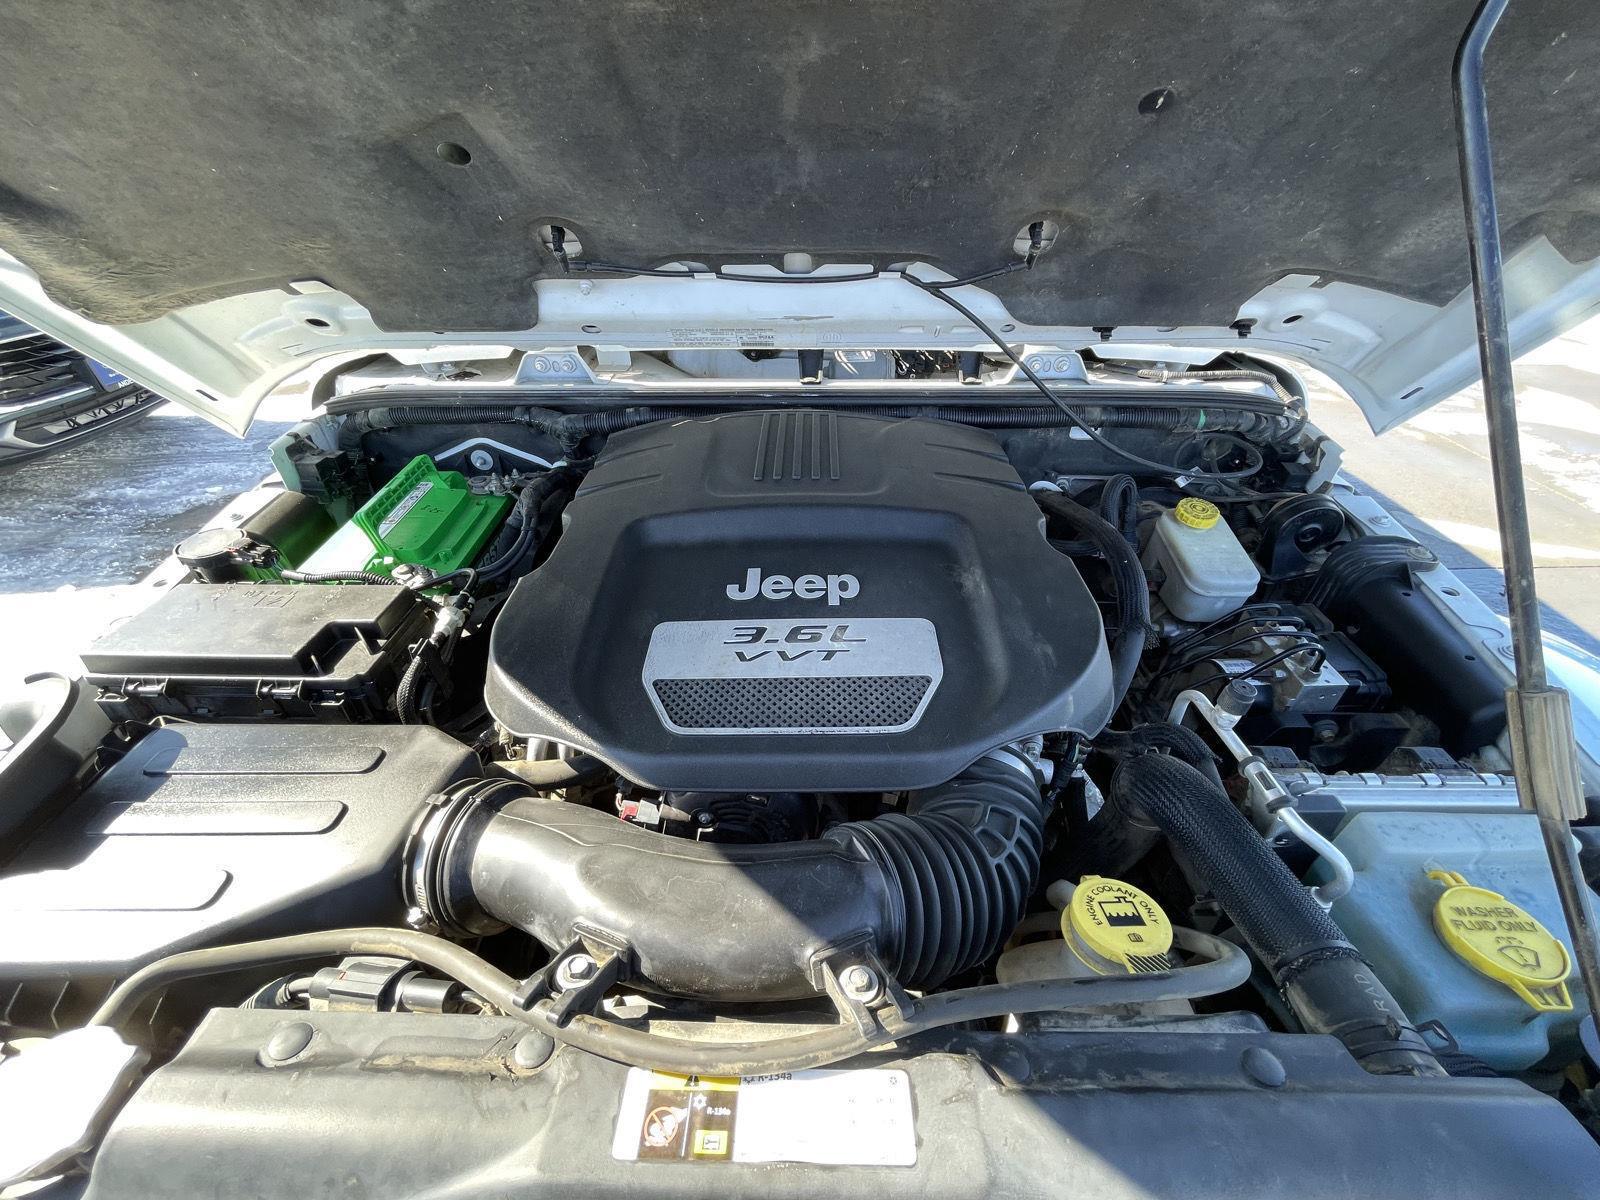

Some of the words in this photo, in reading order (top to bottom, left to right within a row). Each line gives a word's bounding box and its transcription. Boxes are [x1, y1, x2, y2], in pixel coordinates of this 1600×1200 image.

[726, 568, 860, 606] Jeep
[724, 625, 867, 645] 3.6L
[735, 650, 851, 663] VVT
[1091, 885, 1138, 899] COOLANT
[1085, 895, 1104, 926] ENGINE
[1139, 900, 1160, 925] ONLY
[1450, 906, 1519, 918] WASHER
[1451, 919, 1498, 931] FLUID
[1497, 921, 1539, 932] ONLY
[1354, 973, 1390, 1012] RAD
